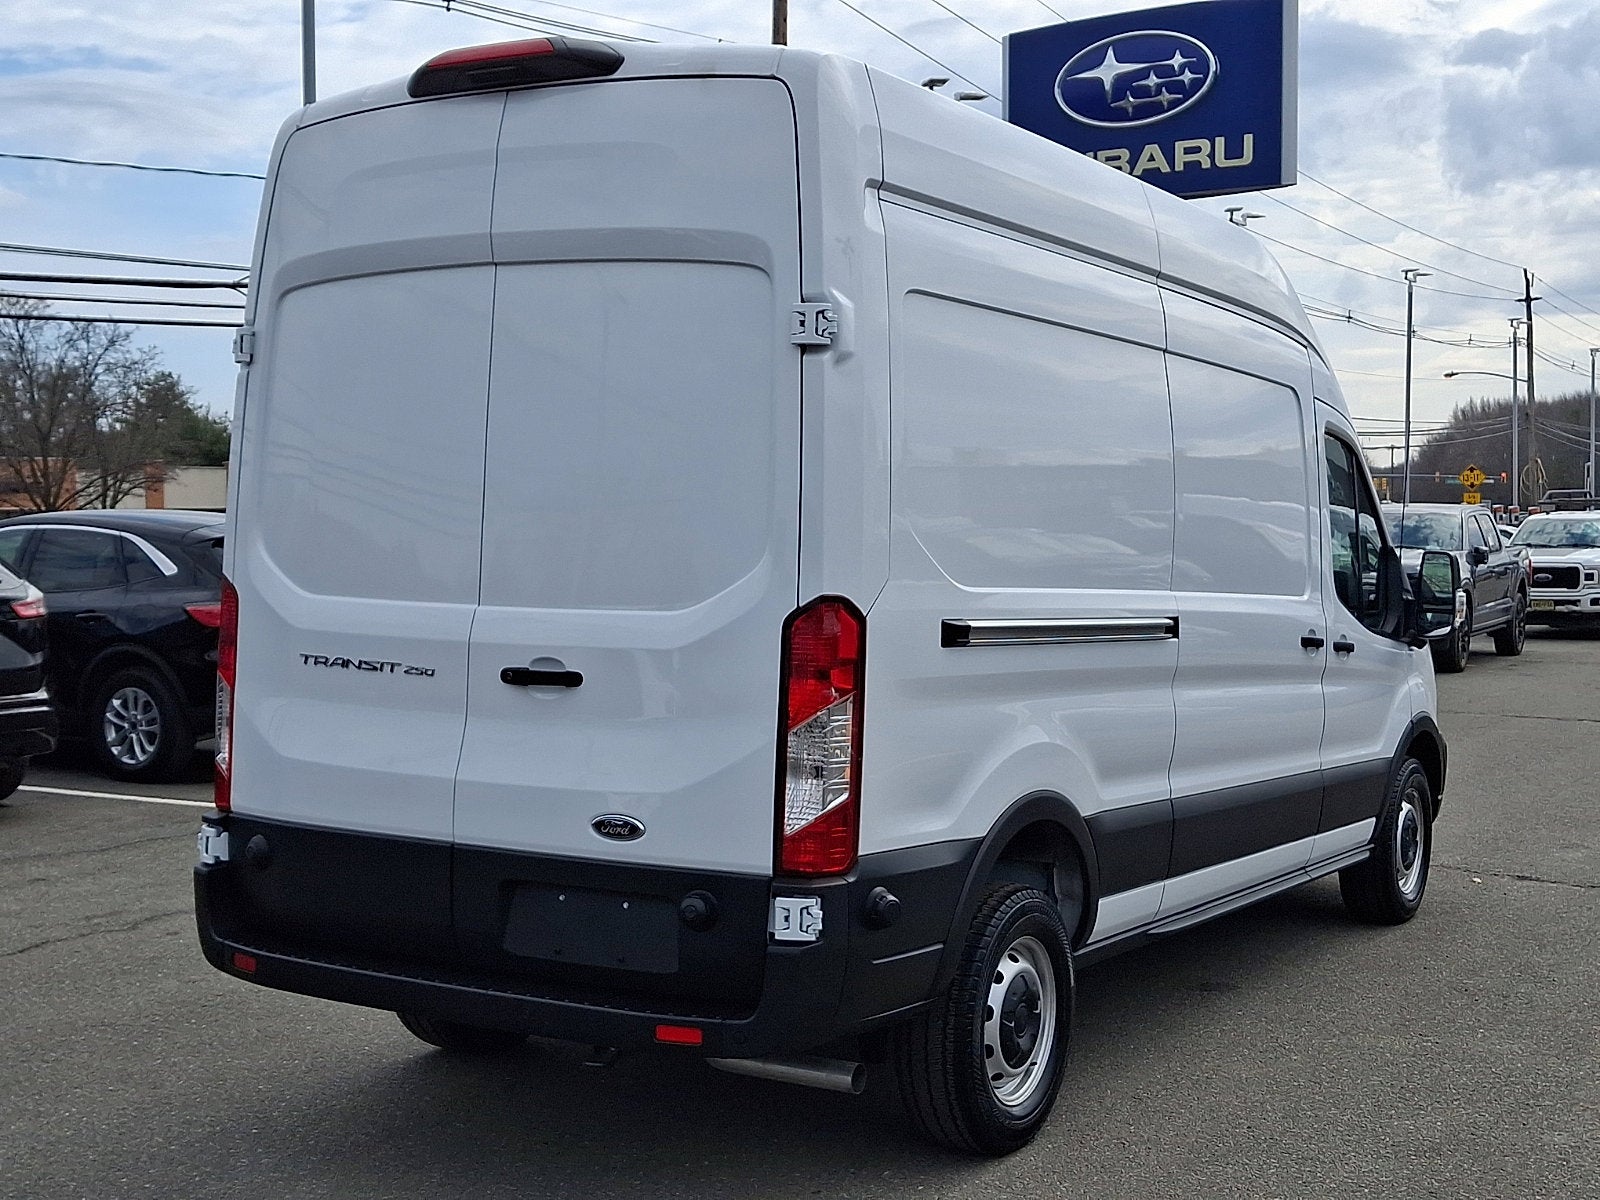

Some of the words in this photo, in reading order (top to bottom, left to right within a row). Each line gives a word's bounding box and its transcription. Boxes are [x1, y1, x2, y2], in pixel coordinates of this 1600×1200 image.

[1086, 133, 1254, 176] BARU
[299, 653, 402, 674] TRANSIT
[403, 665, 436, 677] 250
[601, 819, 631, 835] Ford
